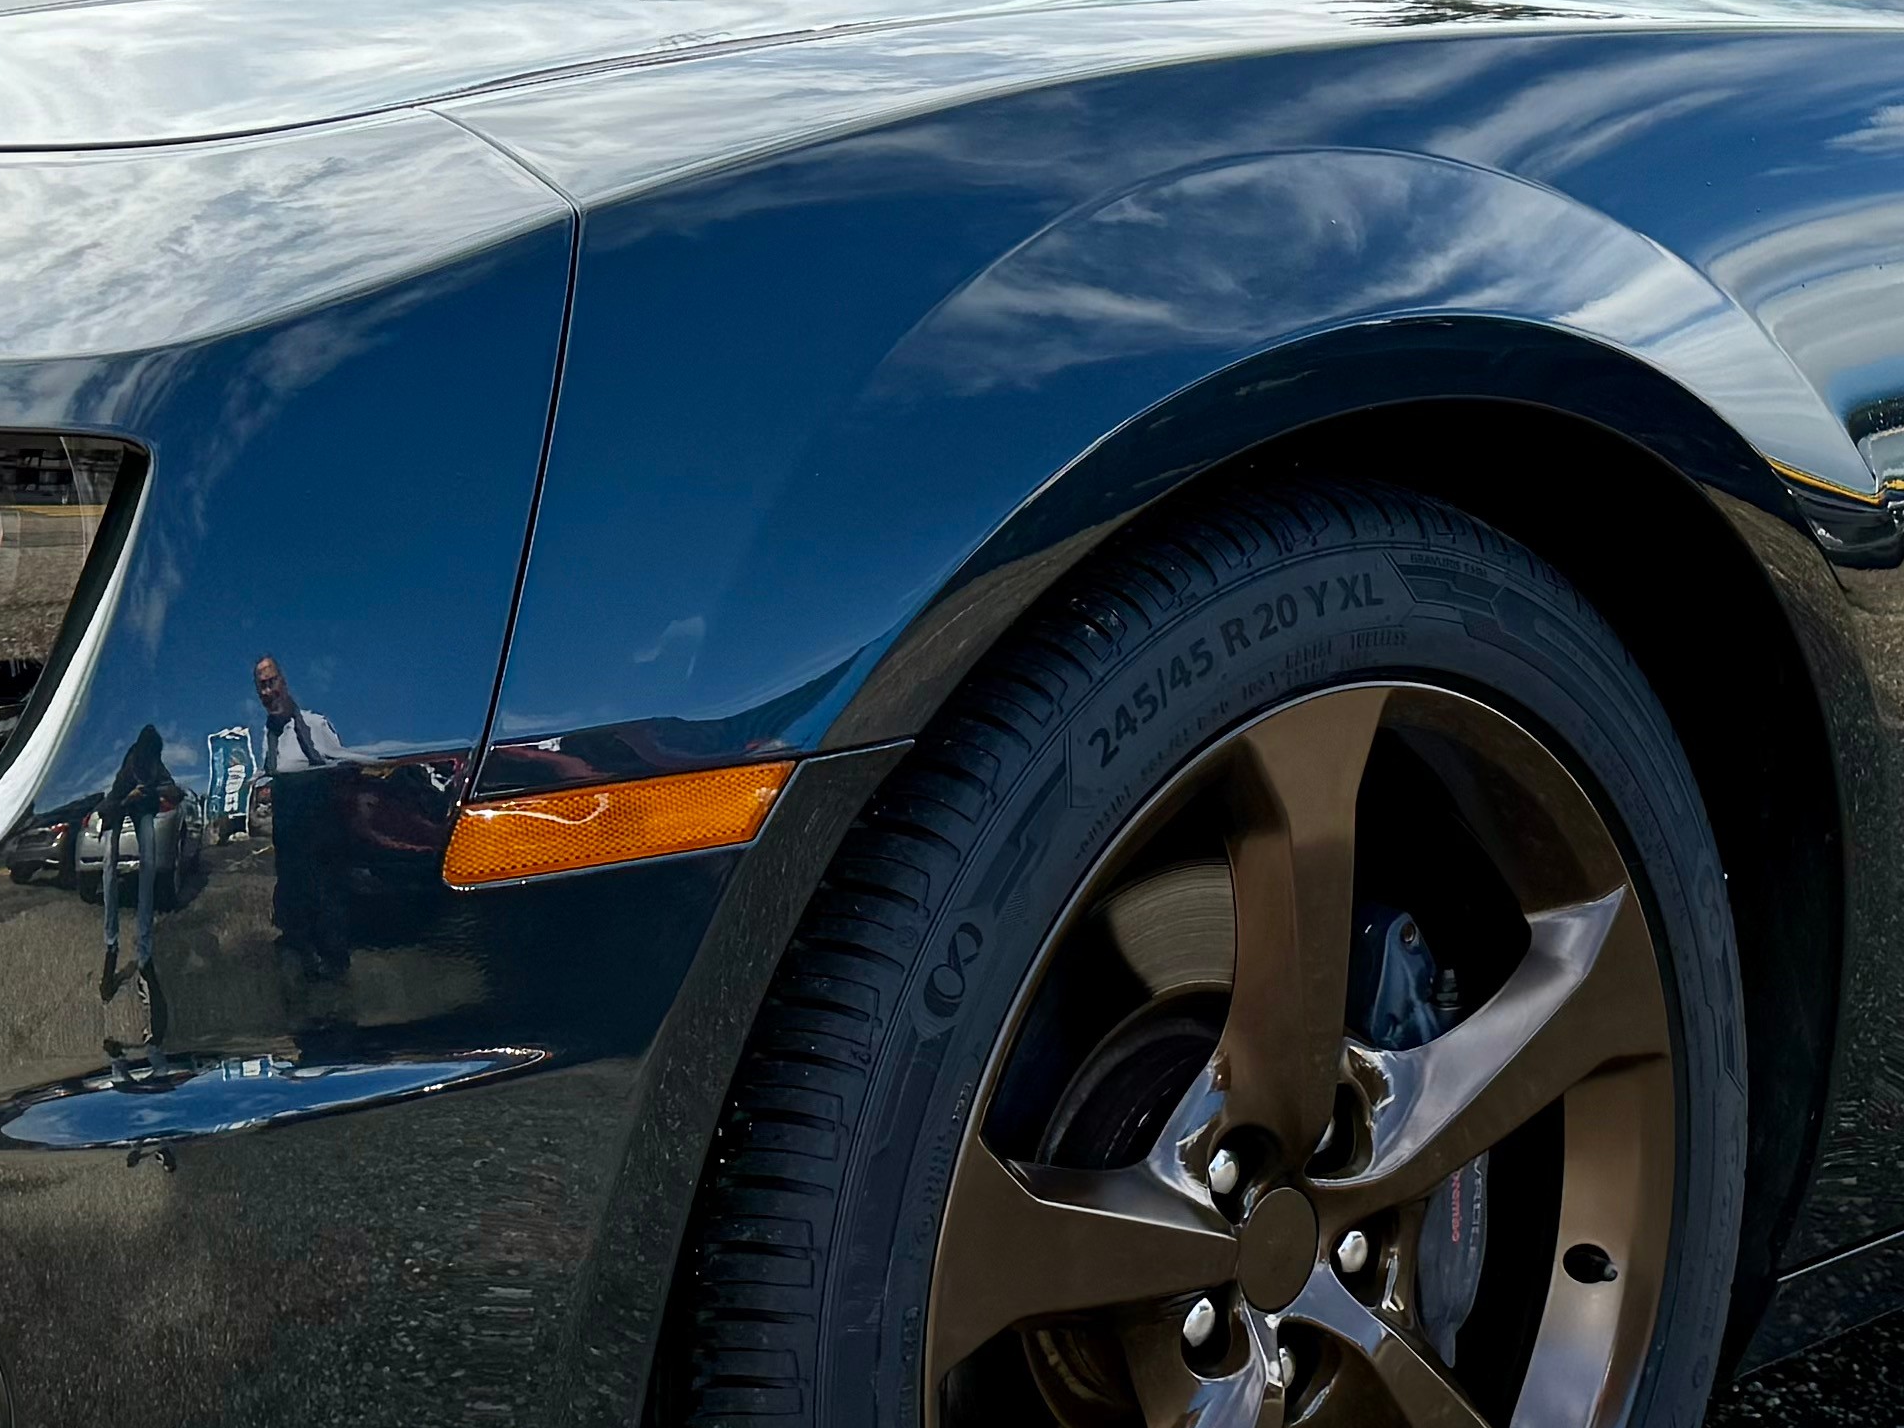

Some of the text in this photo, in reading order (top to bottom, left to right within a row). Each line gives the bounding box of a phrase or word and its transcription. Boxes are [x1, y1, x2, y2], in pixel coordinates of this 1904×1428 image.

[1087, 637, 1215, 769] 245/45
[1218, 617, 1252, 658] R
[1252, 592, 1297, 641] 20
[1303, 580, 1329, 618] Y
[1336, 572, 1385, 612] XL
